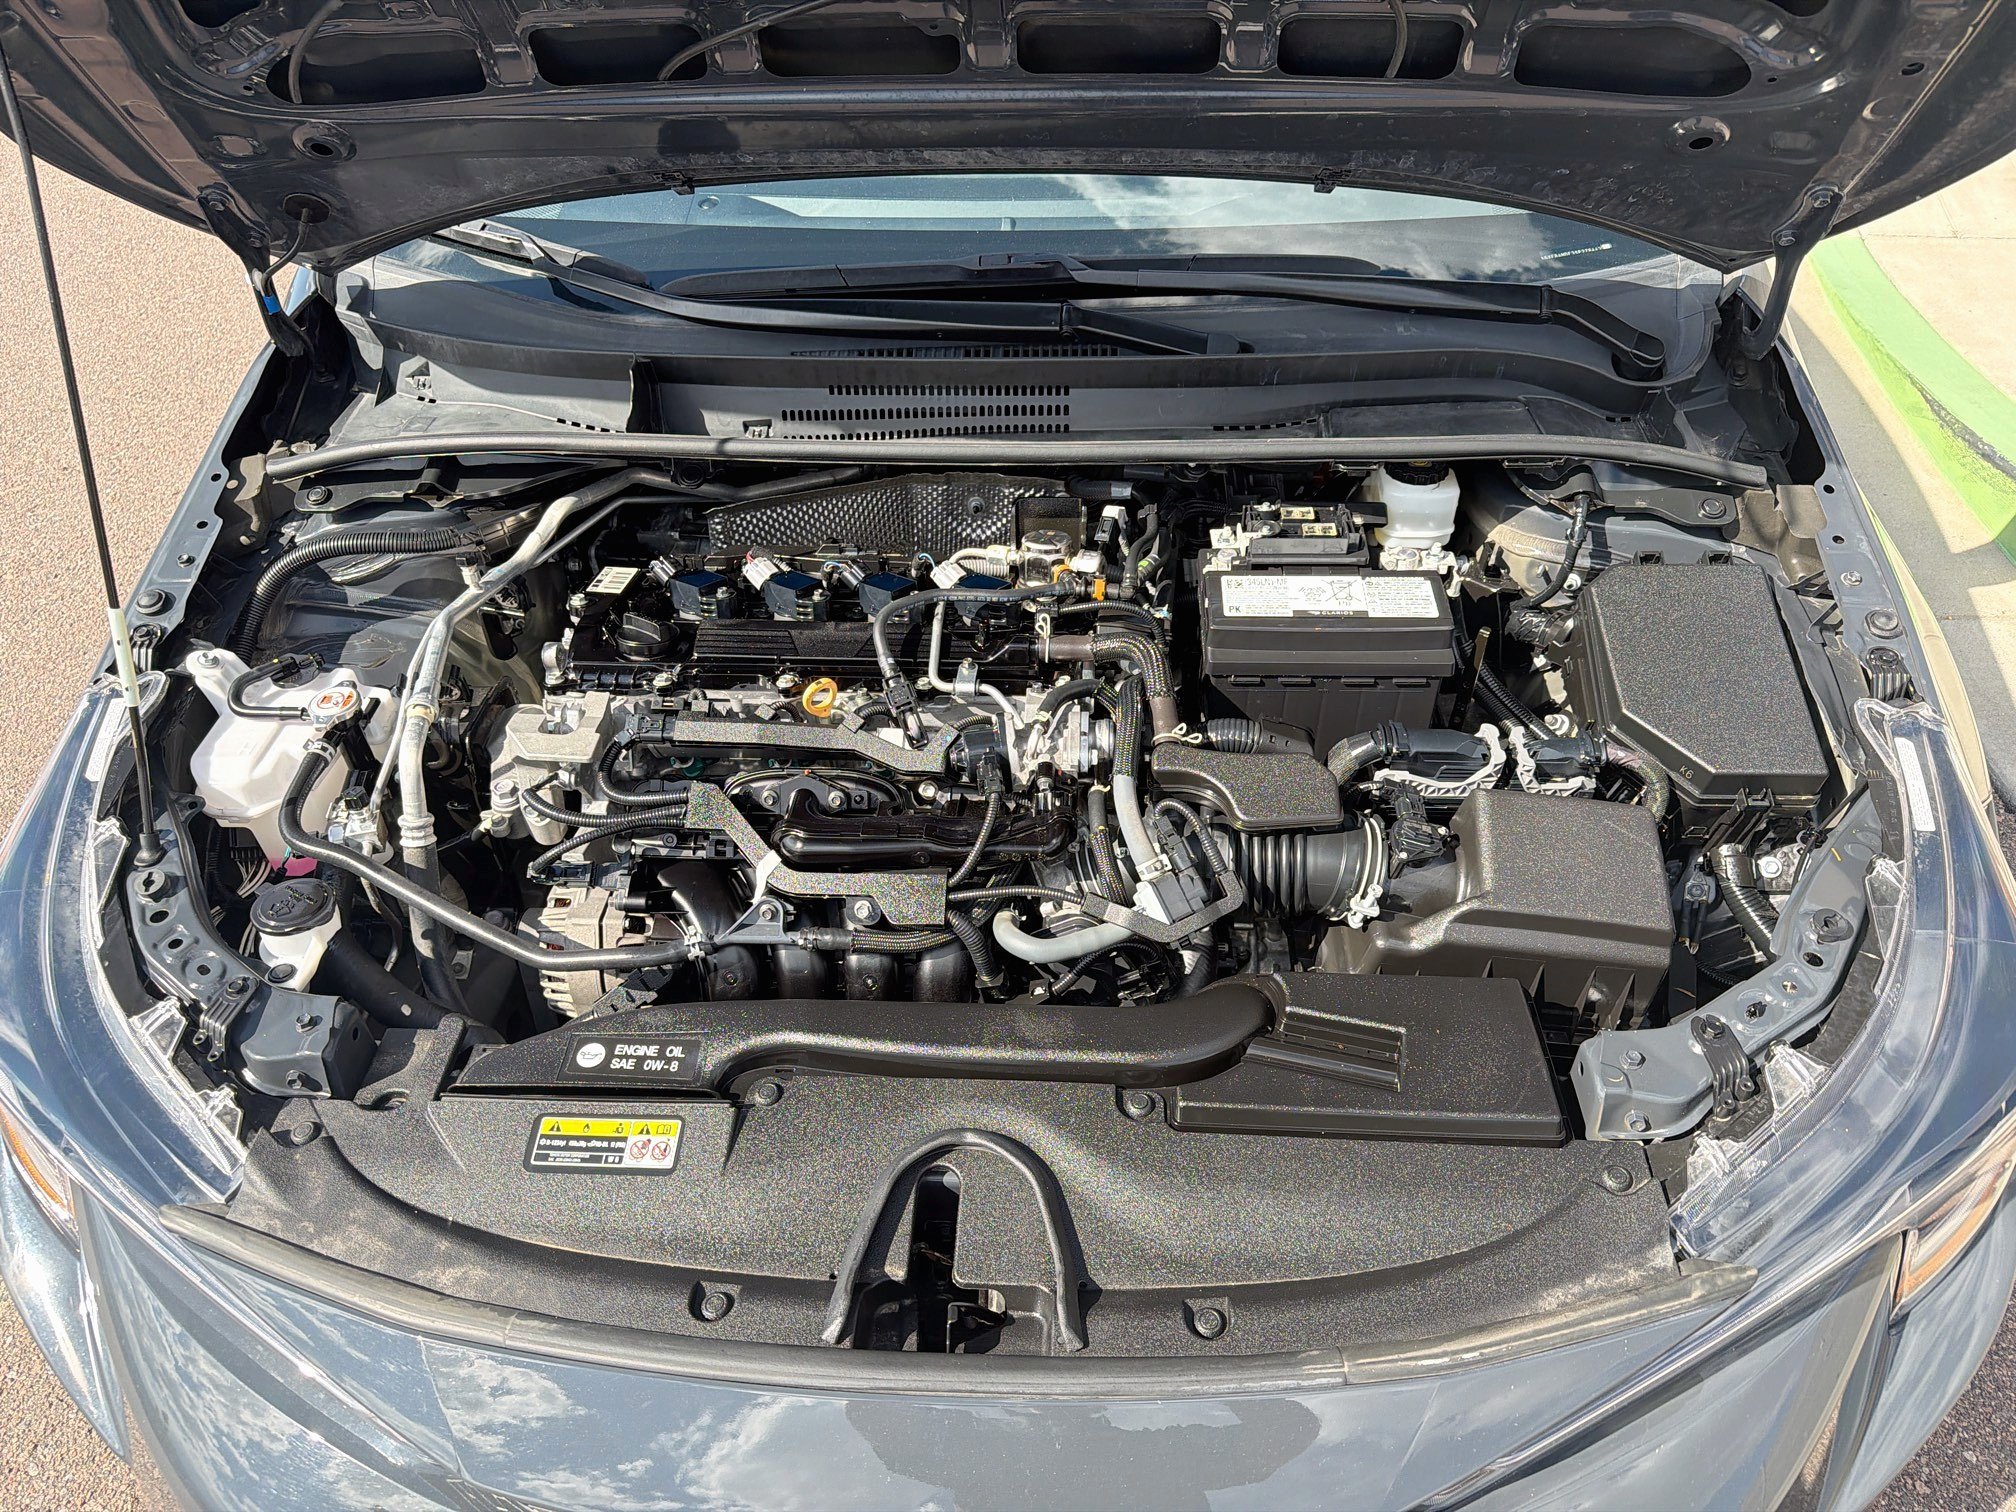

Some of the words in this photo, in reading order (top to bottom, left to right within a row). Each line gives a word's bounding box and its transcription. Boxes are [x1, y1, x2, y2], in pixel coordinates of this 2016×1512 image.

[1679, 765, 1694, 779] K6
[614, 1044, 660, 1057] ENGINE
[665, 1046, 685, 1057] OIL
[610, 1058, 637, 1069] SAE
[643, 1060, 679, 1072] 0W-8
